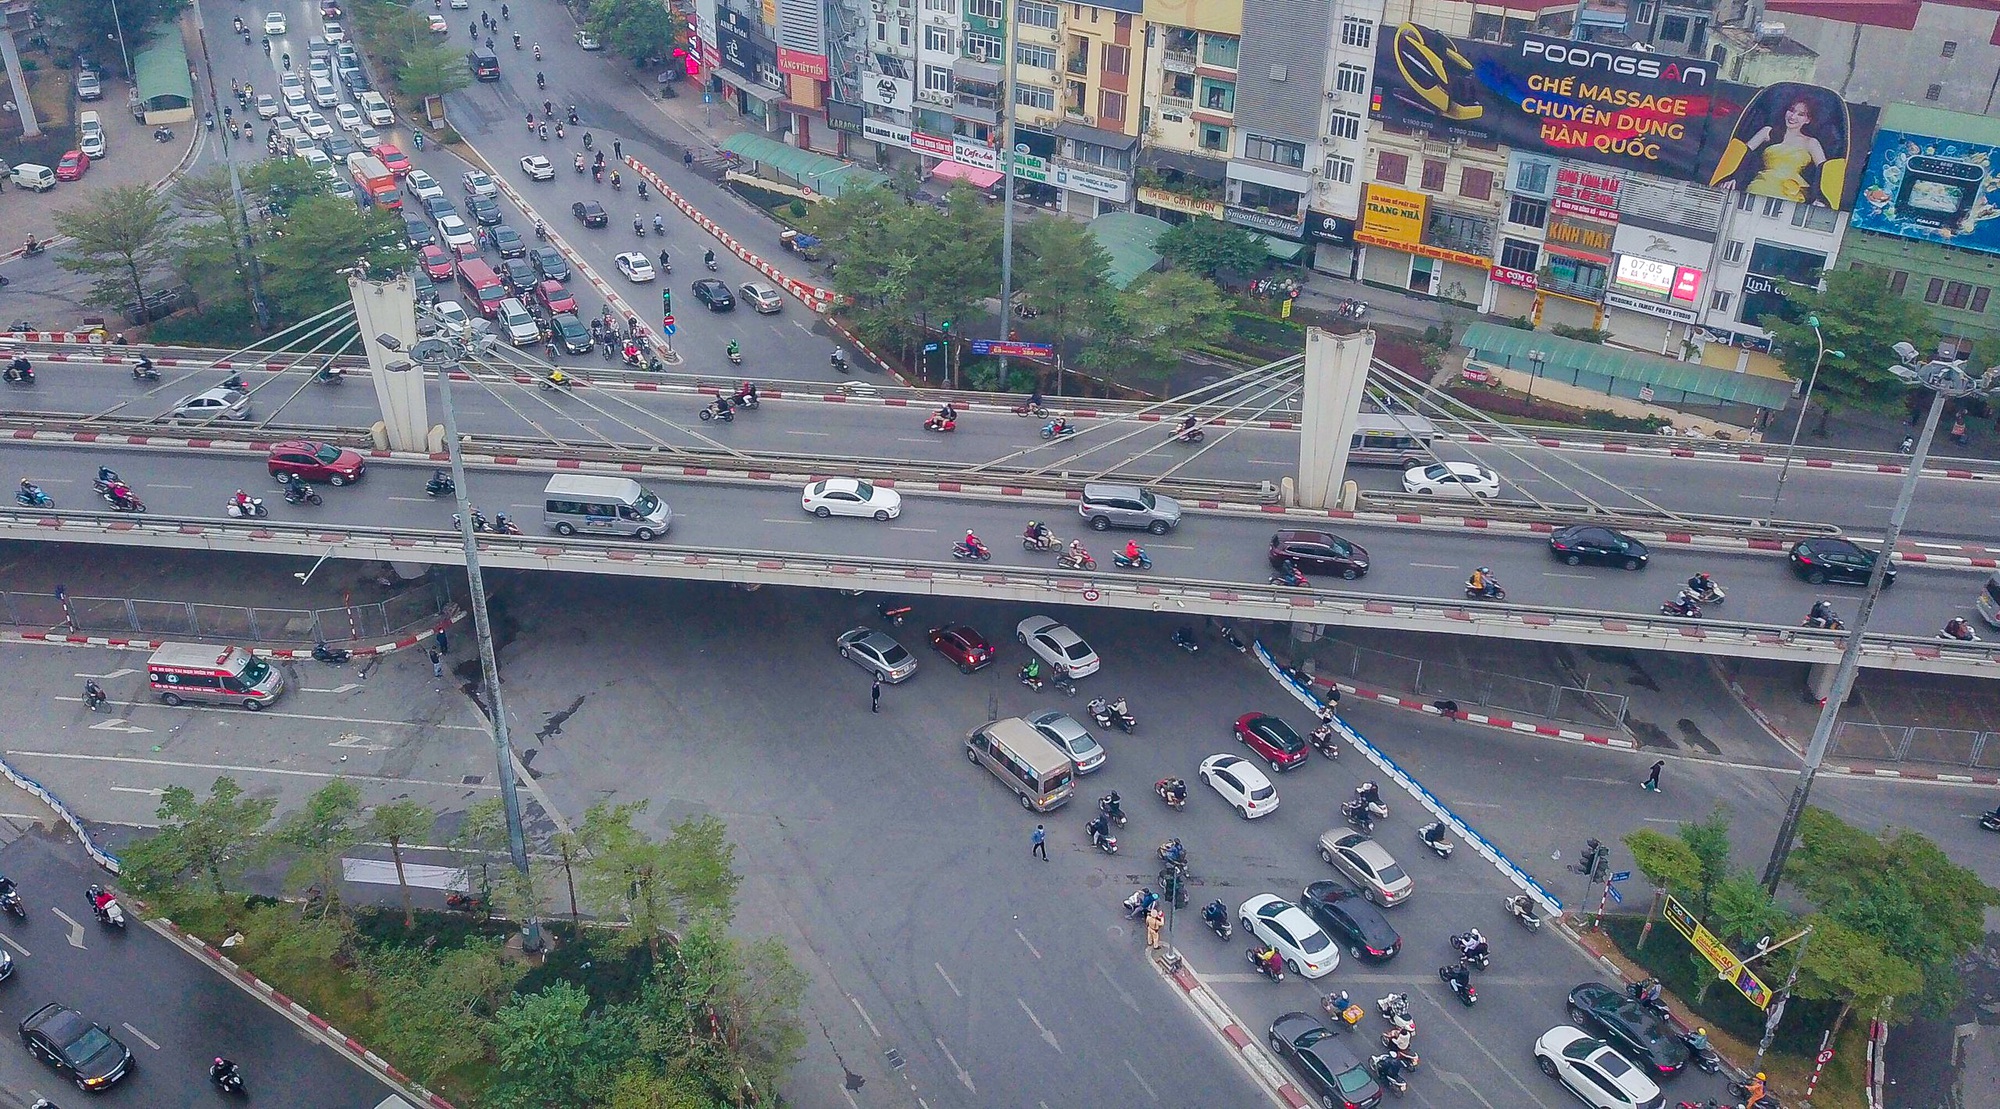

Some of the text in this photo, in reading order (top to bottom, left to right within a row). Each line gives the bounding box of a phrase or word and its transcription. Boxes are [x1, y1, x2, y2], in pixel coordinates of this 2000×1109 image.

[1522, 40, 1706, 87] POONGSAN
[1528, 74, 1688, 116] GHẾ MASSAGE
[830, 118, 860, 131] KARAOKE
[1521, 97, 1686, 140] CHUYÊN DỤNG
[1541, 122, 1661, 160] HÀN QUỐC
[1368, 202, 1398, 216] TRANG
[1226, 208, 1268, 226] Smoothies
[1276, 218, 1298, 232] Juice
[1631, 259, 1663, 274] 07:05
[1745, 277, 1771, 293] Linh
[1656, 306, 1672, 316] PHOTO
[1672, 310, 1692, 320] STUDIO
